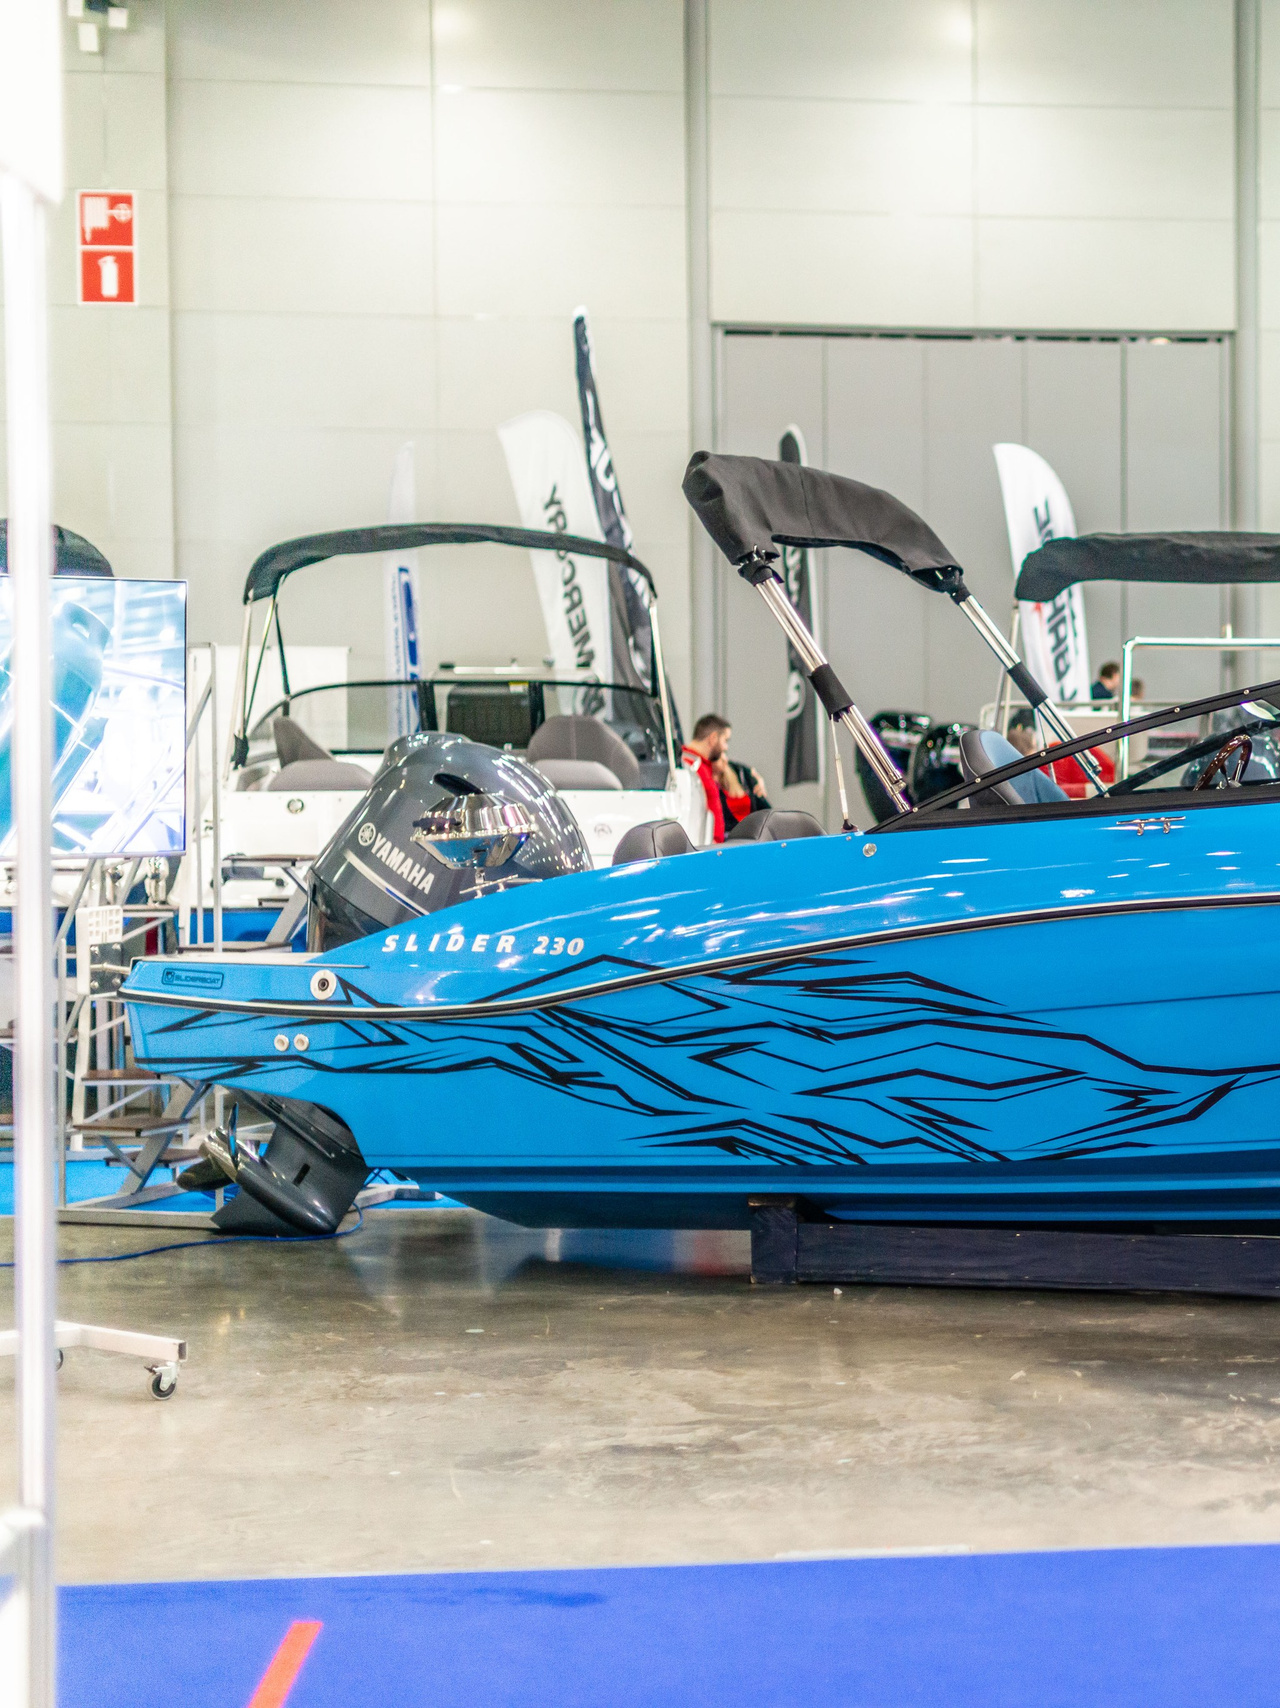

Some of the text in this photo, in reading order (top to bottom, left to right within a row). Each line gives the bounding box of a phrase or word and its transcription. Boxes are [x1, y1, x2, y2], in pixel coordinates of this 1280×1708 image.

[371, 832, 436, 895] YAMAHA
[382, 934, 585, 956] SLIDER 230
